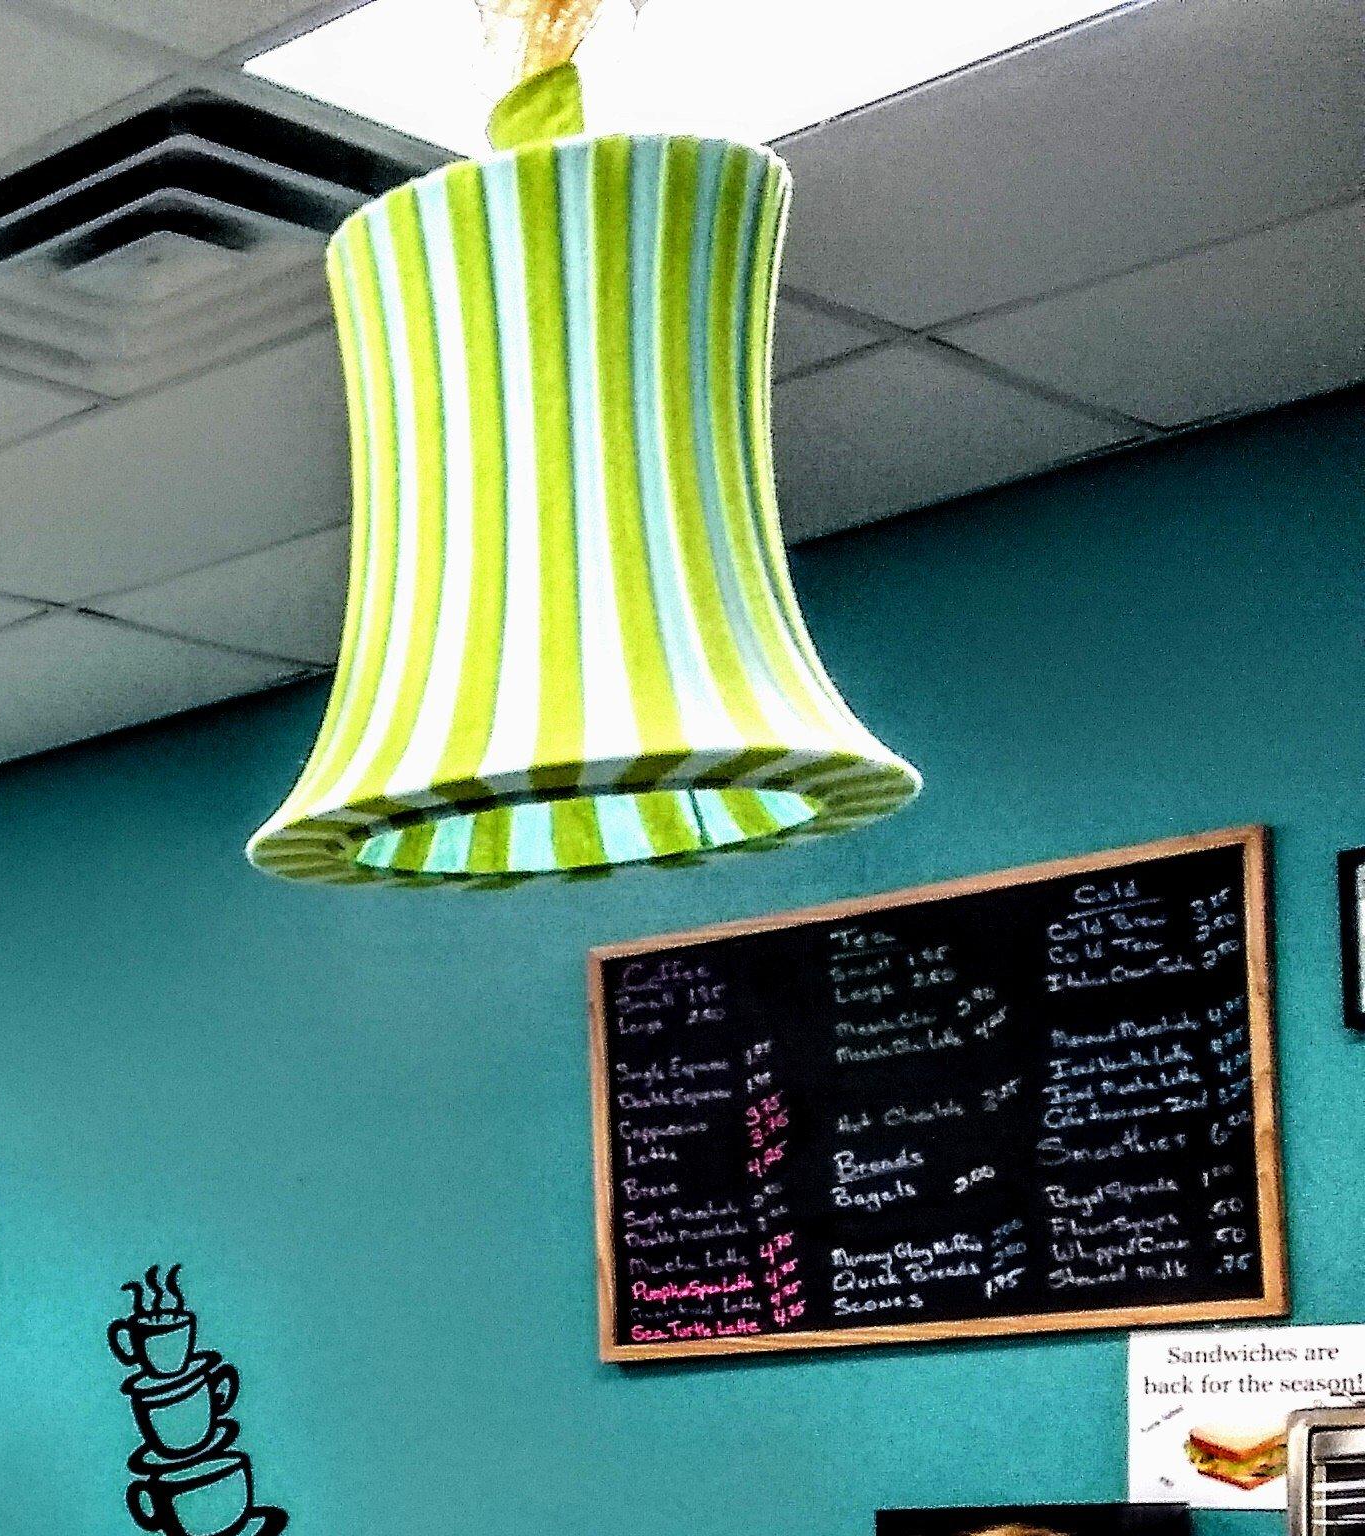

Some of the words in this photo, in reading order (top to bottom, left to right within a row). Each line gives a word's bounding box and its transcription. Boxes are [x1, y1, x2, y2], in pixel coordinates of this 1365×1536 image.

[830, 1179, 917, 1212] Bagels
[1167, 1342, 1298, 1365] Sandwiches
[1303, 1346, 1340, 1362] are
[1143, 1375, 1194, 1395] back
[1201, 1374, 1233, 1394] for
[1238, 1374, 1274, 1394] the
[1279, 1372, 1364, 1395] season!
